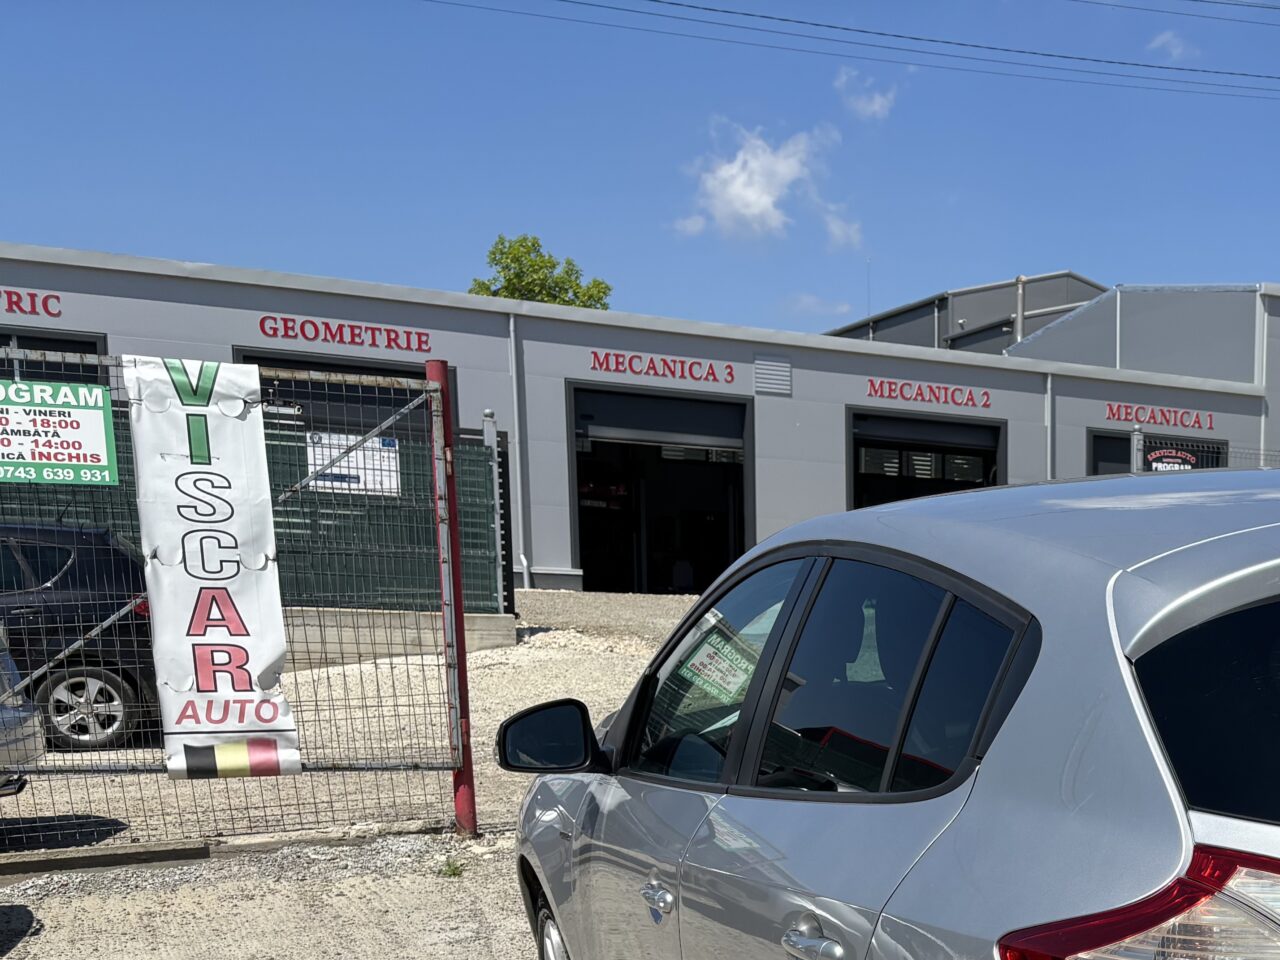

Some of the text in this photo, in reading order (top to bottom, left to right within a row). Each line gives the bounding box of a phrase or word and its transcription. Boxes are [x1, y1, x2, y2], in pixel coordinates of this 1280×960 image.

[0, 290, 62, 317] RIC
[259, 315, 432, 353] GEOMETRIE
[590, 351, 735, 384] MECANICA 3
[0, 383, 104, 407] GRAM
[867, 379, 991, 408] MECANICA 2
[22, 408, 71, 418] VINERI
[29, 417, 81, 430] 18:00
[1106, 403, 1214, 430] MECANICA 1
[30, 439, 82, 450] 14:00
[30, 448, 102, 464] ÎNCHIS
[43, 467, 75, 480] 639
[80, 469, 110, 482] 931
[161, 357, 257, 693] VISCAR
[175, 699, 279, 725] AUTO
